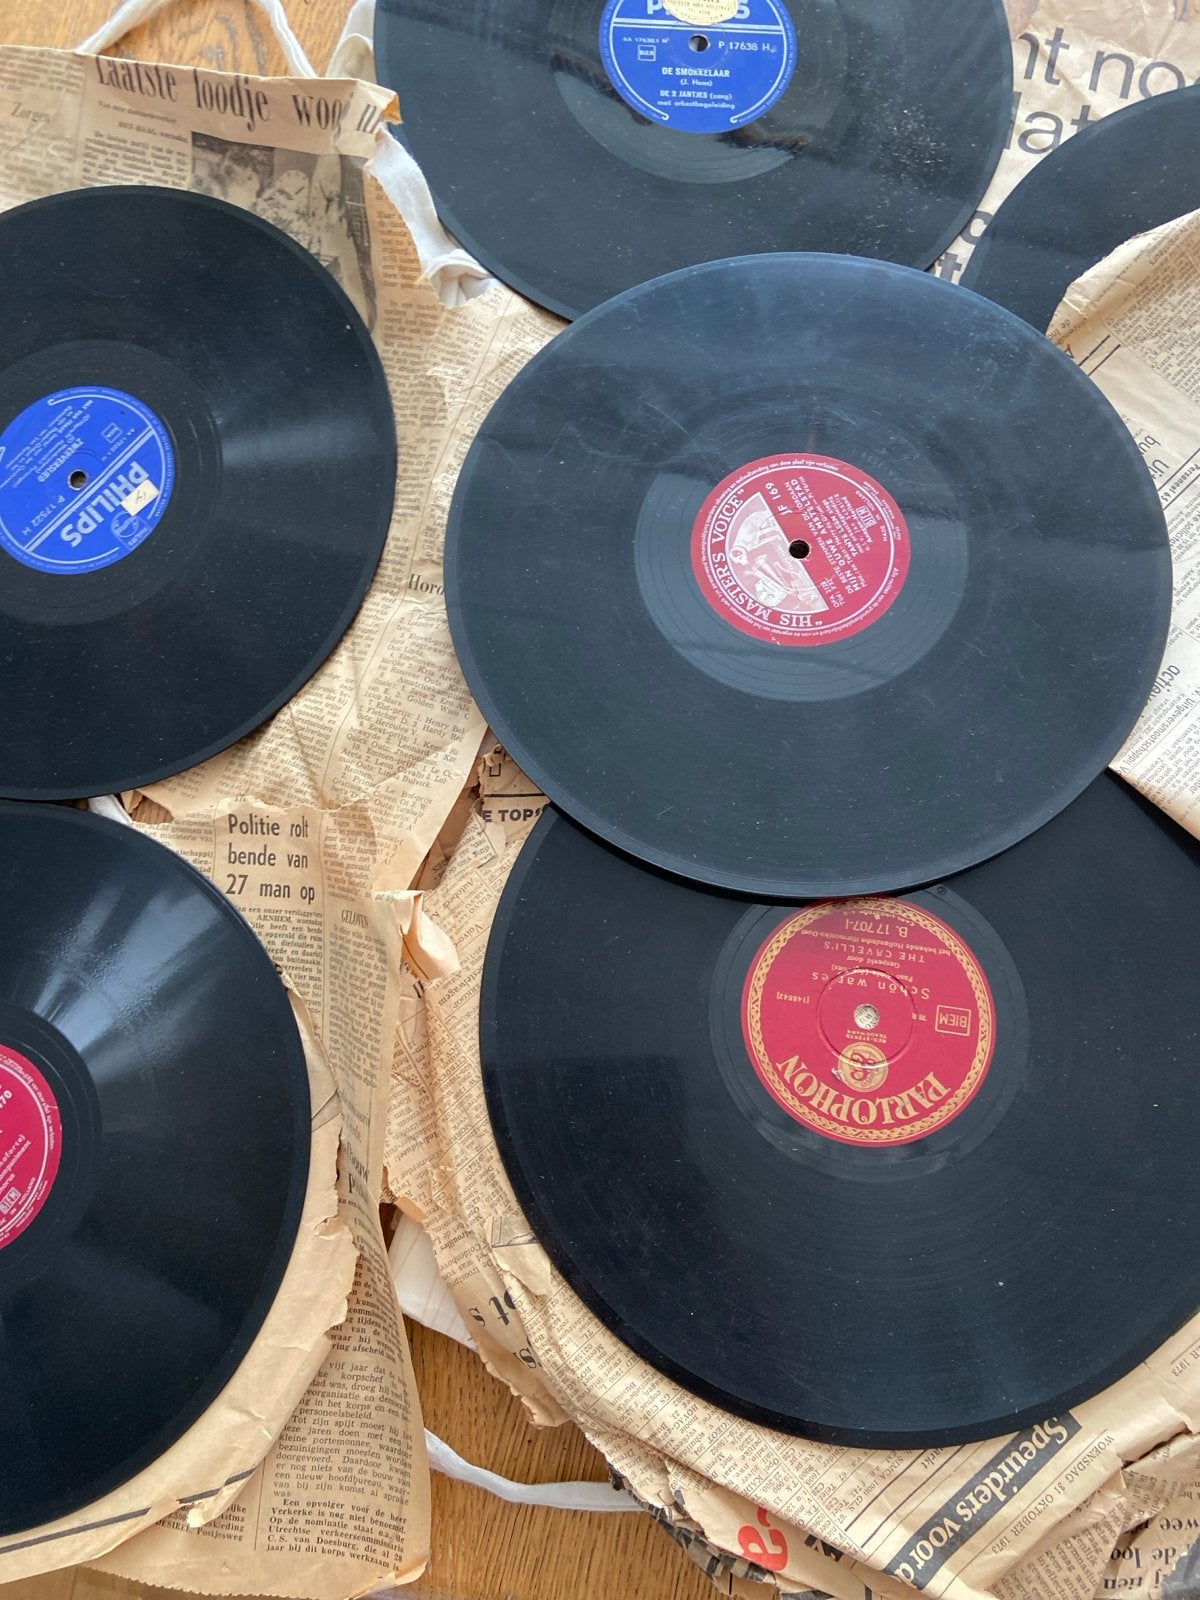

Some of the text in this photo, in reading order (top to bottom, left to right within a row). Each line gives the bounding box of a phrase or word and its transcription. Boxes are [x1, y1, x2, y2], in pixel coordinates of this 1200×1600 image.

[729, 42, 757, 50] 17638
[675, 68, 730, 77] SMOKKELAAR
[1089, 50, 1200, 100] no
[194, 68, 270, 132] loodje
[678, 91, 707, 99] JANTJES
[60, 463, 146, 544] PHILIPS
[765, 481, 791, 515] JF 169
[855, 489, 874, 511] HOLLAND
[30, 504, 56, 526] 17522
[802, 511, 809, 520] DE
[831, 515, 843, 532] LEEN
[857, 506, 874, 526] BIEM
[791, 478, 860, 590] MIJN OUWE AMSTELSTAD
[808, 522, 818, 535] VAN
[817, 536, 835, 564] STEMMEN
[842, 533, 857, 555] TANTE
[854, 542, 863, 553] met
[834, 565, 846, 583] BESTE
[712, 551, 771, 620] MASTER'S
[845, 584, 853, 593] DE
[228, 813, 308, 837] Politie rolt
[228, 842, 307, 868] bende van
[225, 873, 314, 904] 27 man op
[894, 925, 908, 938] B.
[823, 938, 924, 963] THE CAVELLI'S
[846, 954, 863, 962] door
[904, 942, 936, 954] bekende
[811, 971, 829, 981] es
[938, 1011, 968, 1028] BIEM
[775, 1054, 950, 1124] PARLOPHON
[278, 1443, 340, 1454] bezuinigingen
[312, 1436, 372, 1448] portemonnee,
[276, 1452, 333, 1462] doorgevoerd.
[877, 1455, 902, 1479] SIMCA
[892, 1417, 1067, 1590] Speurders voor d
[990, 1434, 1114, 1554] WOENSDAG 31 OKTOBER 1973
[271, 1507, 312, 1515] Verkerke
[349, 1514, 365, 1522] niet
[370, 1517, 405, 1533] benoemd.
[306, 1500, 344, 1509] opvolger
[351, 1504, 369, 1513] voor
[390, 1513, 407, 1524] heer
[269, 1516, 282, 1525] Op
[304, 1519, 347, 1528] nominatie
[353, 1525, 373, 1533] staat
[395, 1534, 404, 1543] de
[269, 1525, 403, 1552] Utrechtse verkeerscommissaris
[266, 1544, 284, 1552] jaar
[288, 1544, 301, 1552] bij
[321, 1547, 345, 1556] korps
[349, 1552, 389, 1567] werkzaam
[316, 1537, 358, 1550] Doesburg,
[364, 1545, 376, 1554] die
[393, 1554, 402, 1562] 28
